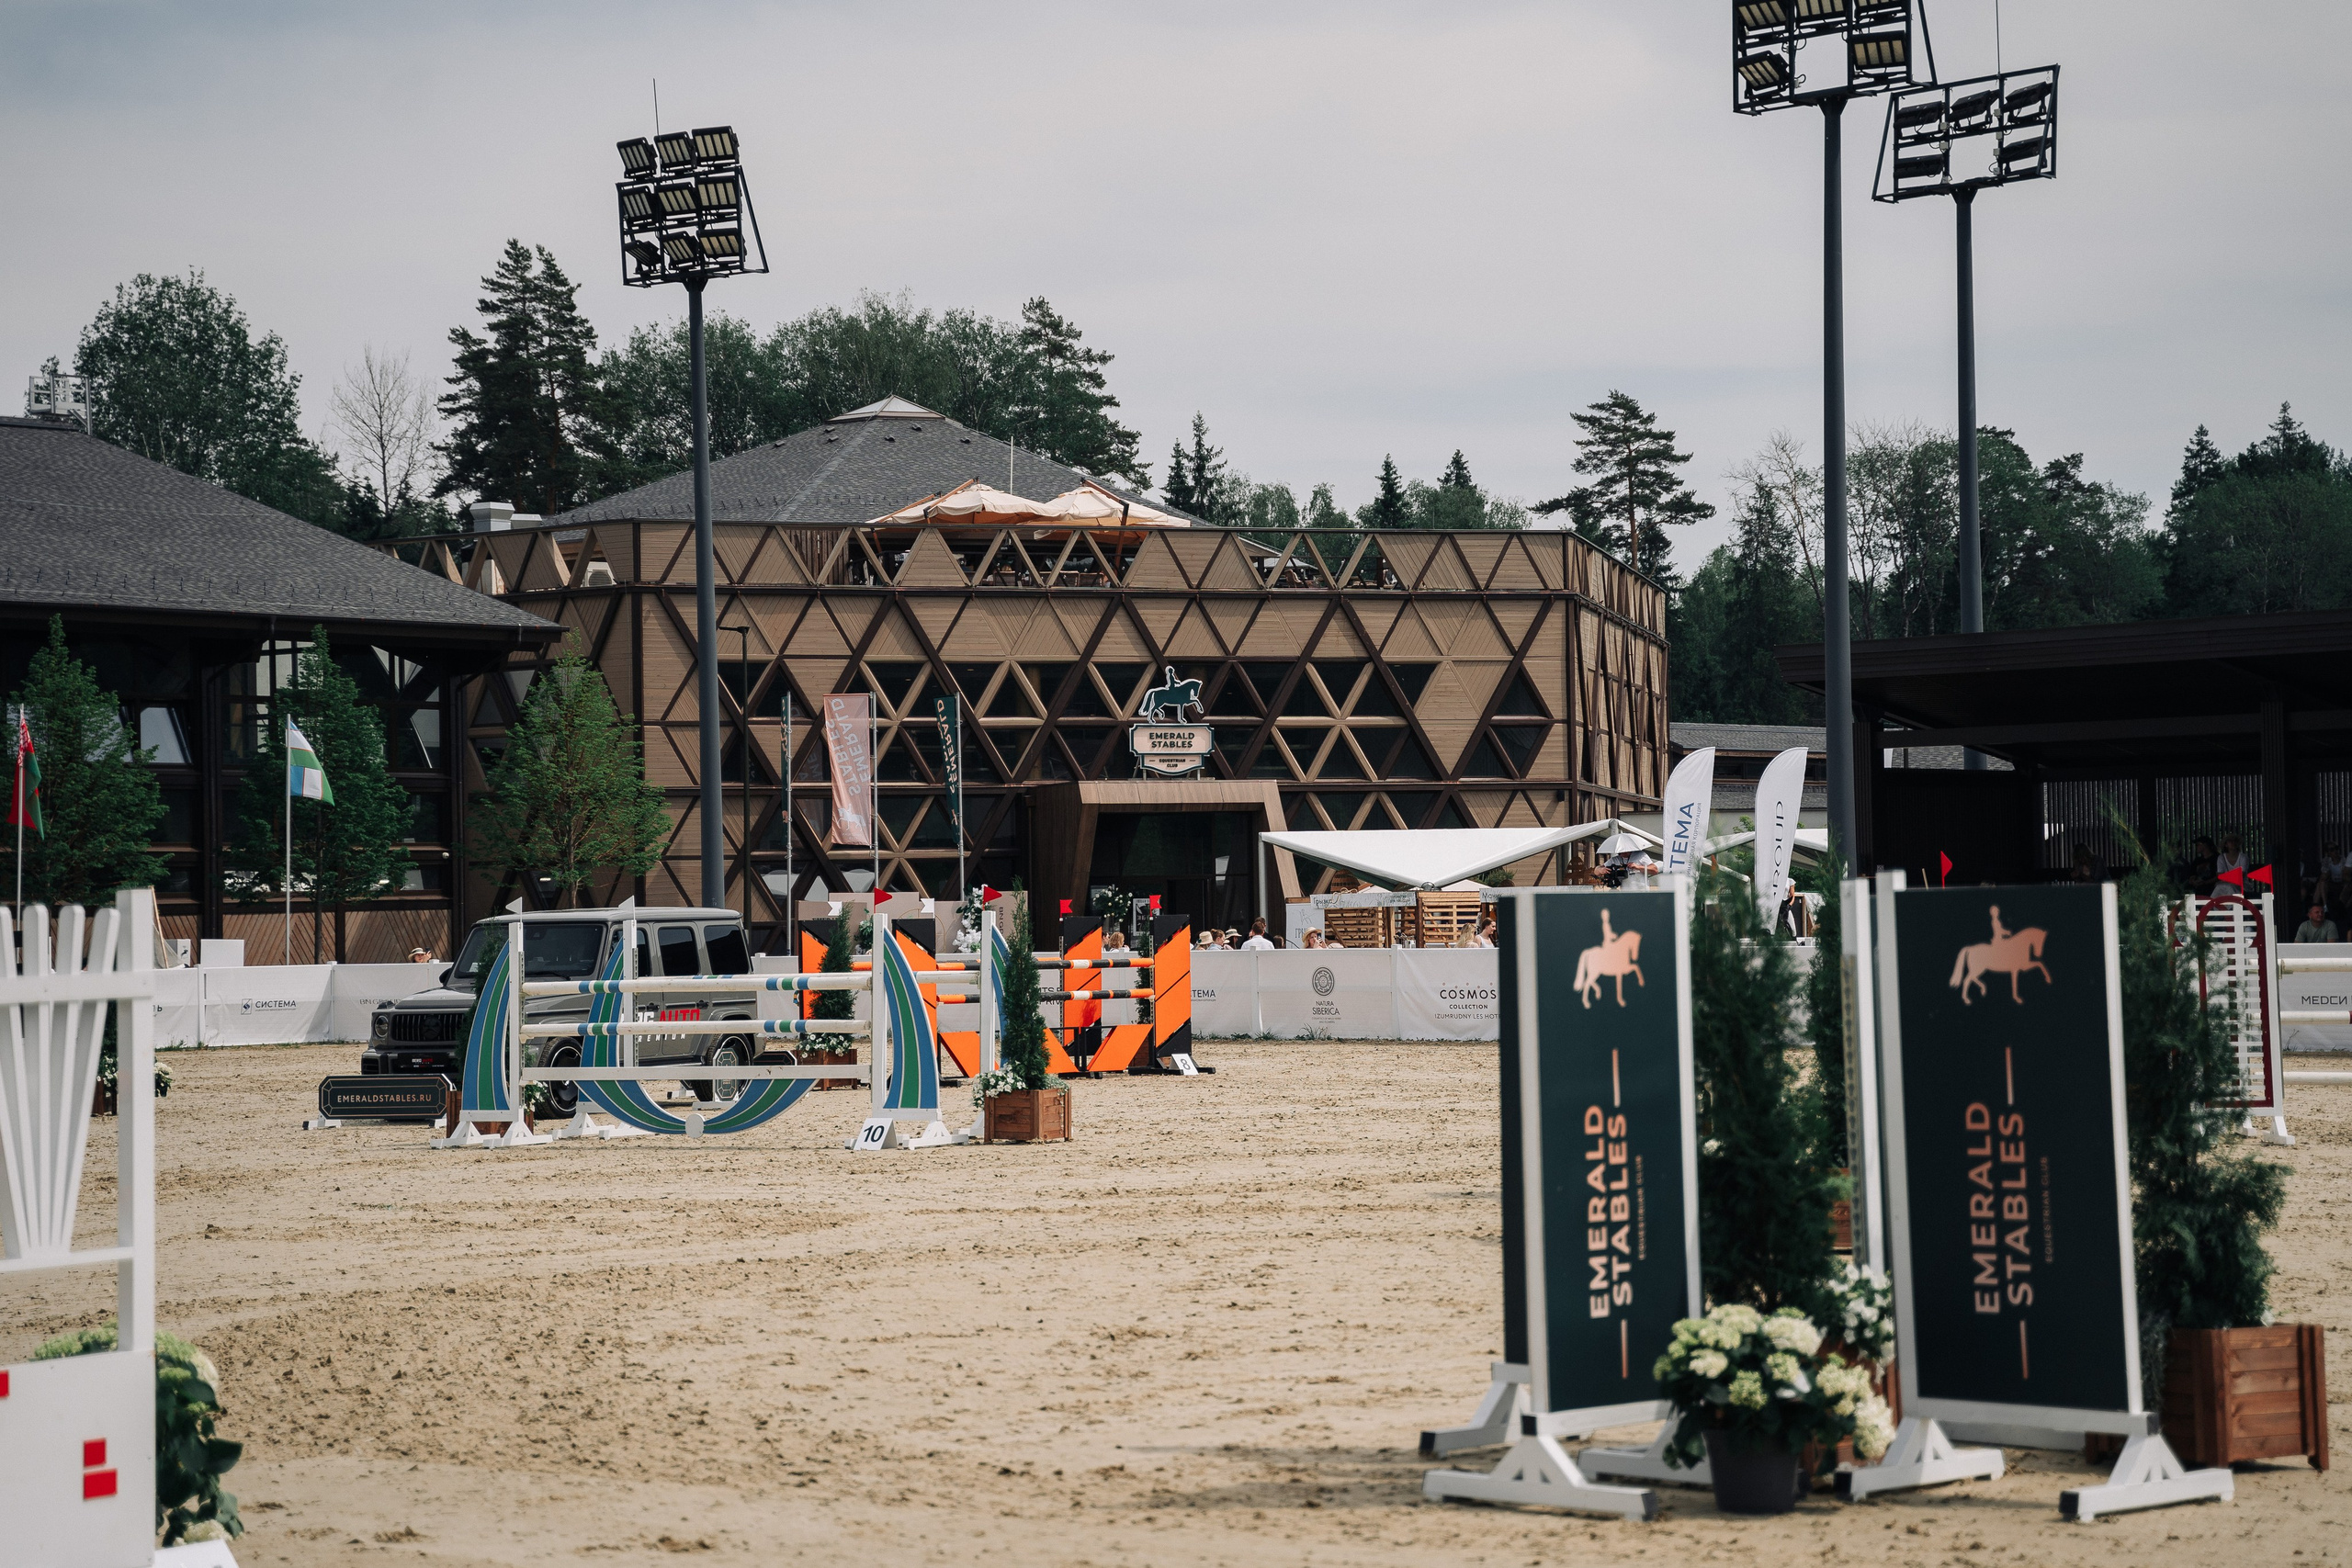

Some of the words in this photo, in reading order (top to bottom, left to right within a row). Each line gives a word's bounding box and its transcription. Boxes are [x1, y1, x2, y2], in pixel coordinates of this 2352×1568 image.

[1148, 732, 1195, 740] EMERALD
[1151, 740, 1193, 749] STABLES
[1669, 802, 1695, 874] ТЕМА
[1770, 800, 1784, 912] ROUP
[1191, 989, 1216, 998] ТЕМА
[1440, 989, 1497, 999] COSMOS
[254, 999, 297, 1009] СИСТЕМА
[1311, 1007, 1340, 1016] SIBERICA
[1180, 1058, 1191, 1070] 8
[337, 1093, 433, 1103] EMERALDSTABLES.RU
[864, 1124, 885, 1143] 10
[2039, 1156, 2050, 1186] CLUB
[1583, 1104, 1611, 1320] EMERALD
[1607, 1113, 1634, 1307] STABLES
[1964, 1101, 2001, 1314] EMERALD
[1997, 1111, 2034, 1307] STABLES
[2041, 1190, 2053, 1264] EQUESTRIAN
